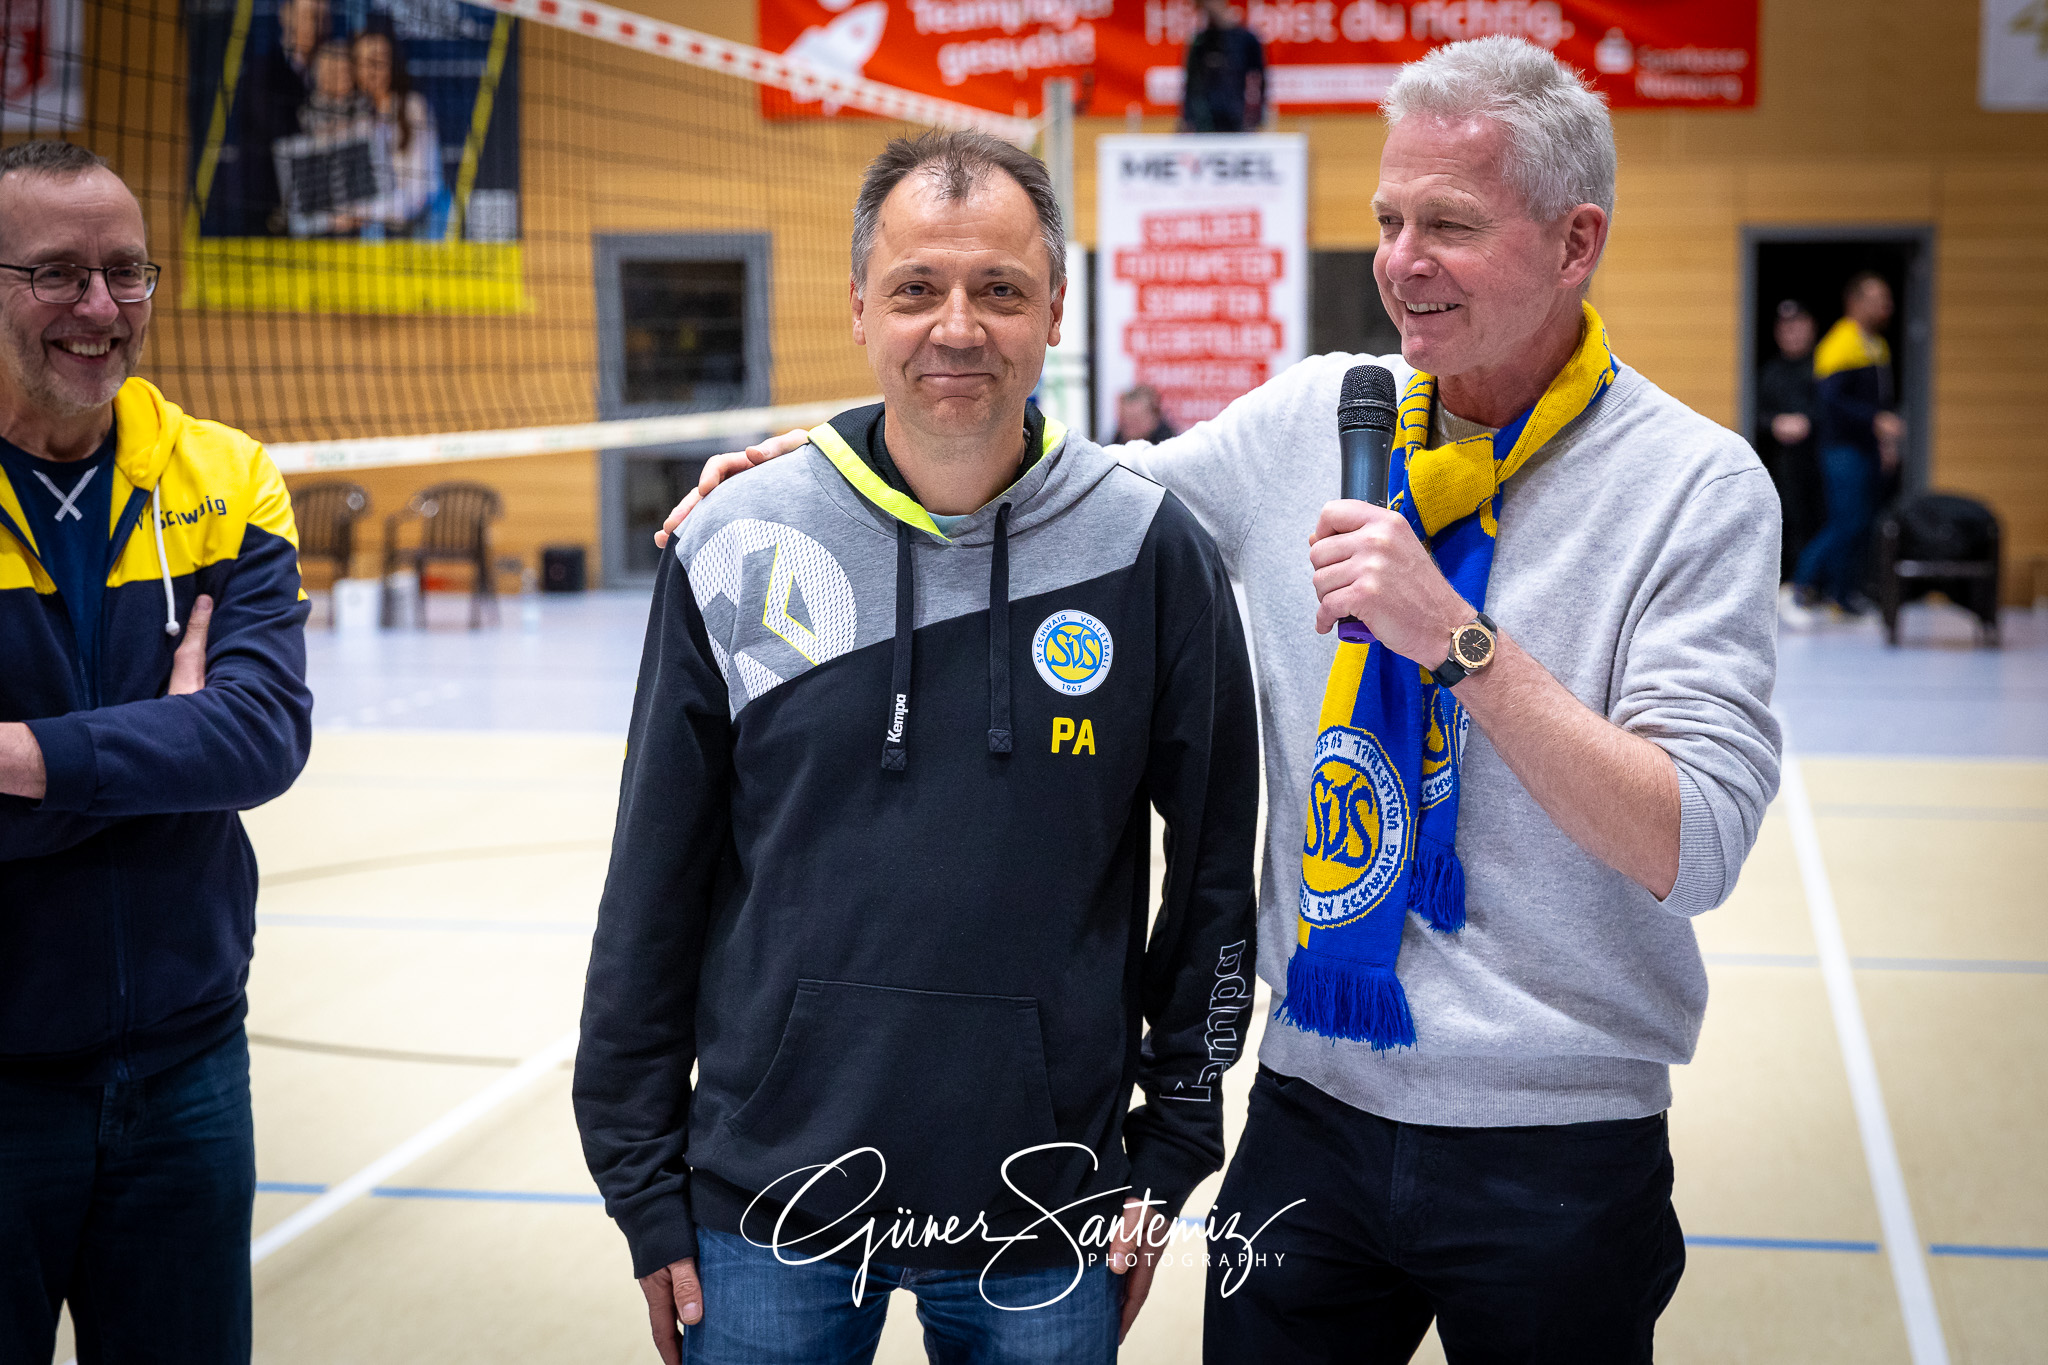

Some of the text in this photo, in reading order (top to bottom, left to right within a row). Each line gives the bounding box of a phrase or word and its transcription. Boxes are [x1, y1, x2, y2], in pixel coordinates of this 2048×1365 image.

[1036, 614, 1110, 669] SV SCHWAIG VOLLEYBALL
[1062, 684, 1082, 692] 1967
[887, 693, 909, 743] Kempa
[1051, 716, 1096, 755] PA
[1341, 844, 1397, 915] SCHWAIG
